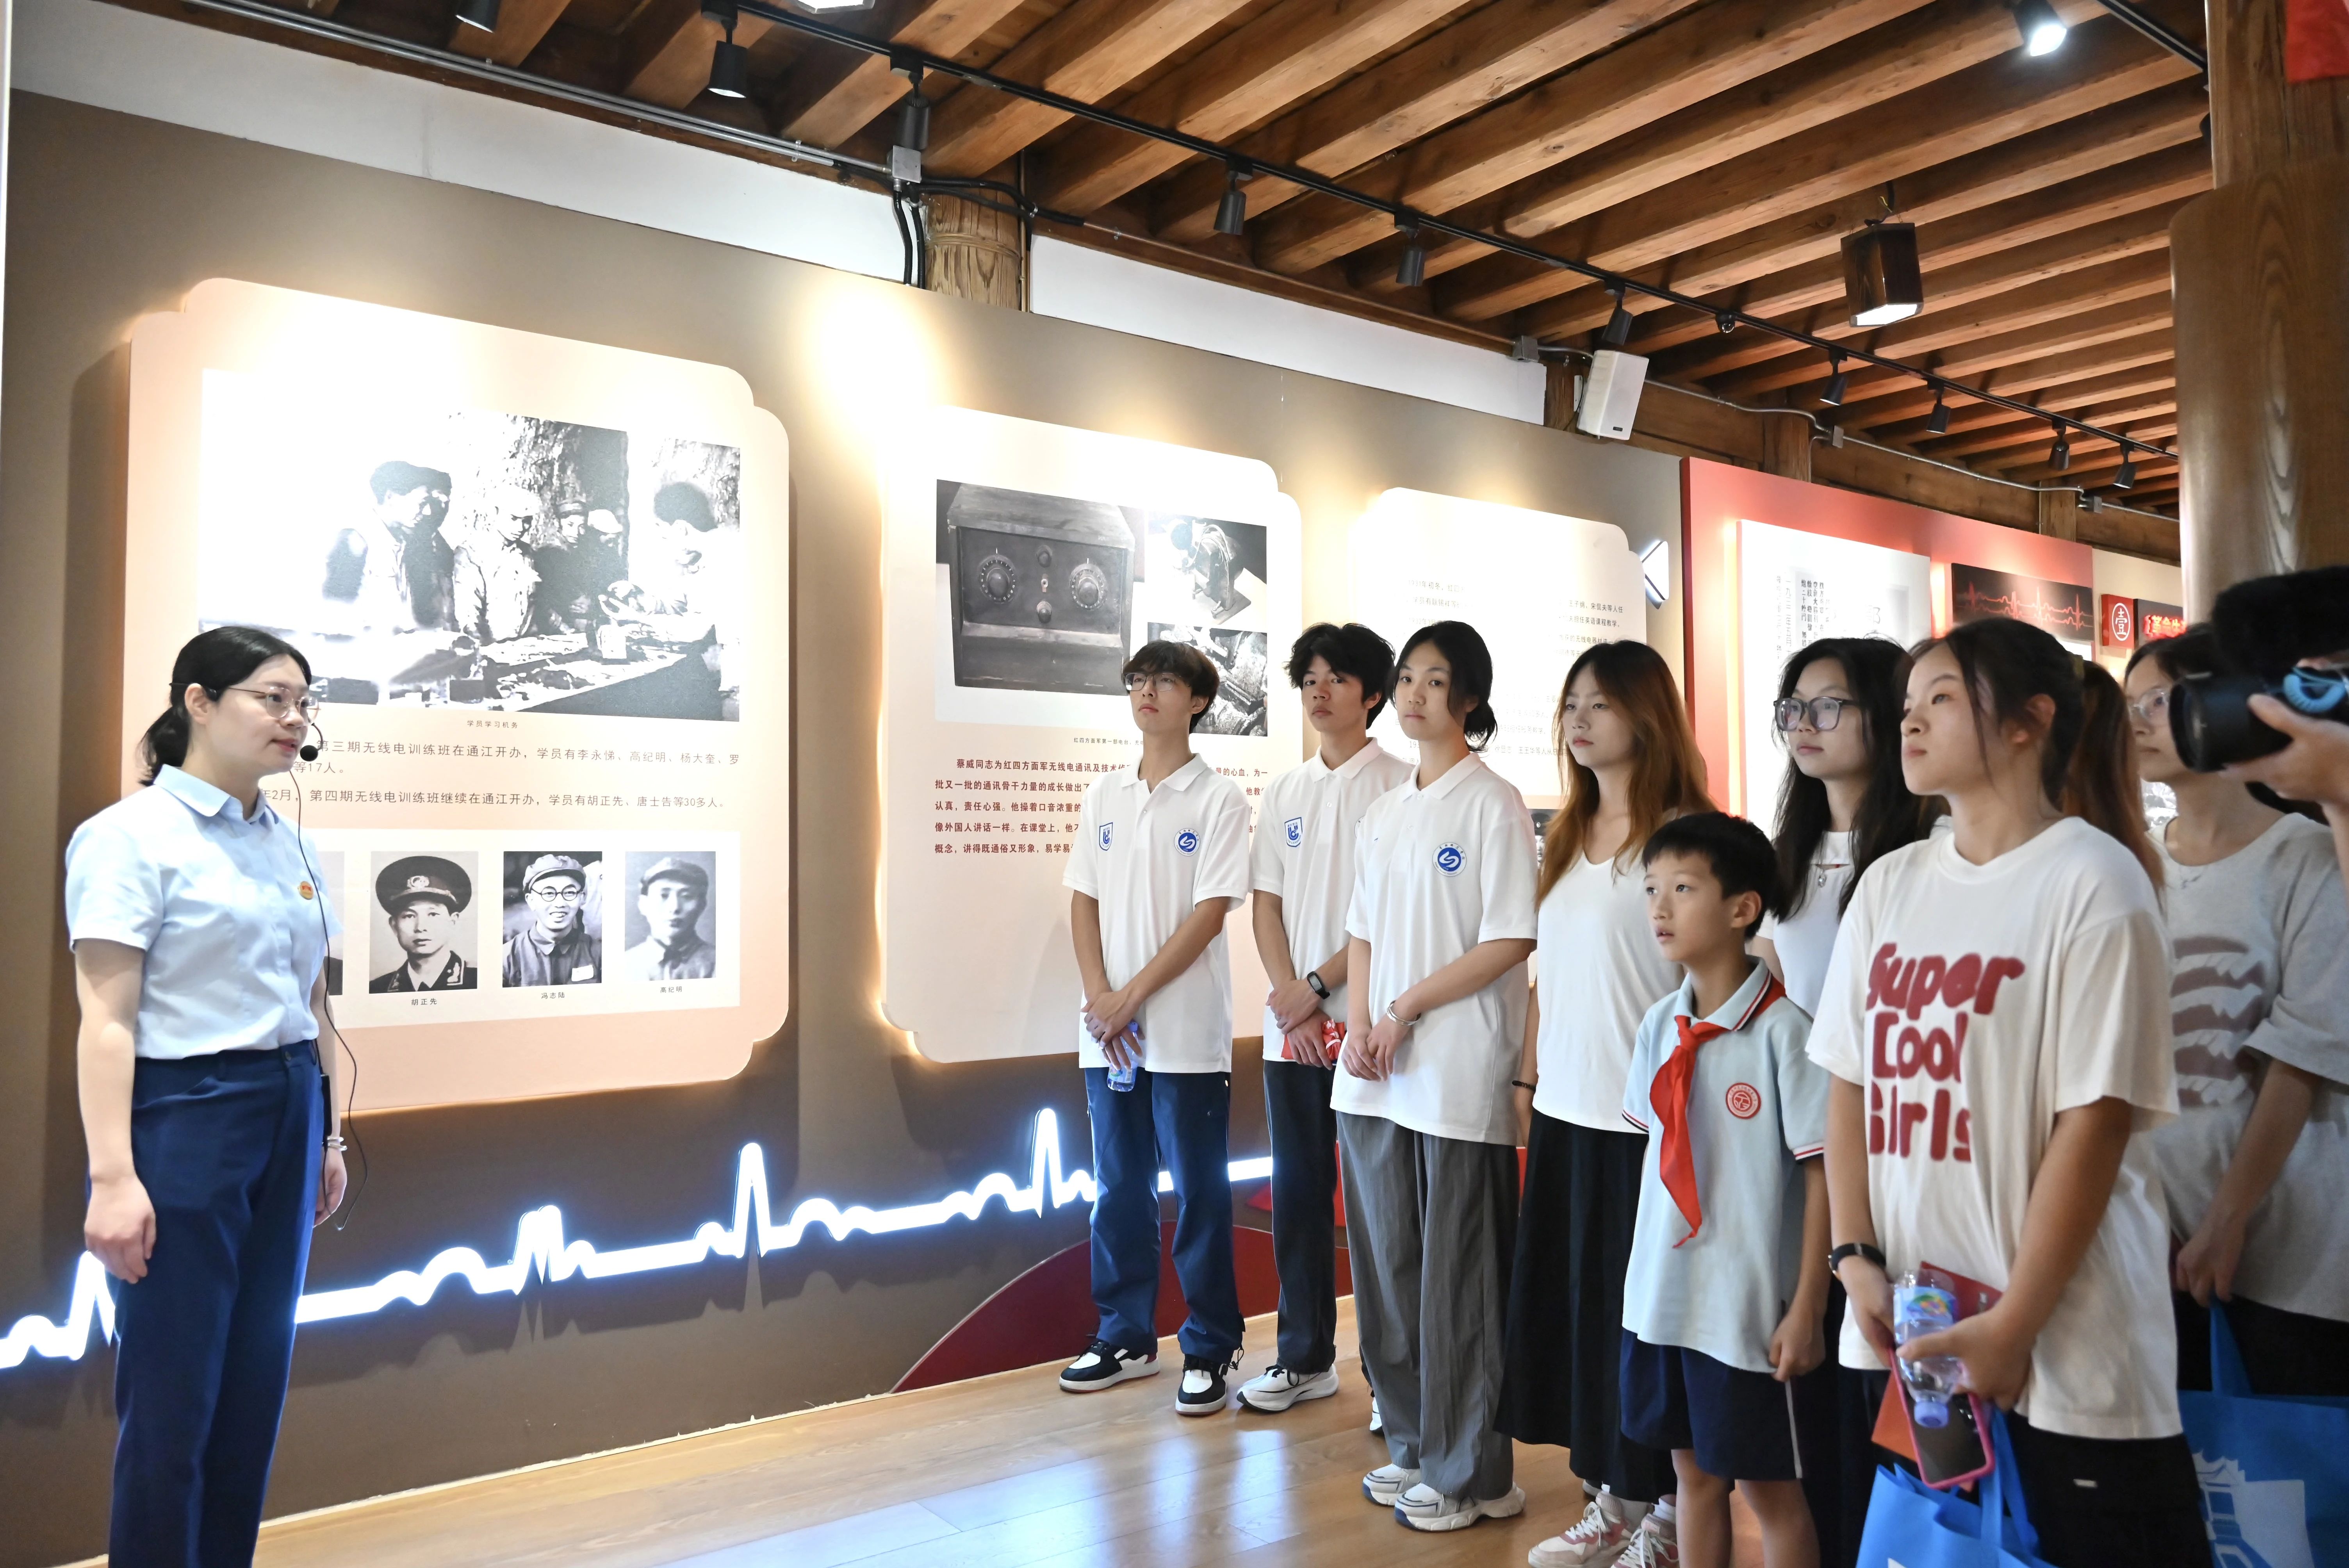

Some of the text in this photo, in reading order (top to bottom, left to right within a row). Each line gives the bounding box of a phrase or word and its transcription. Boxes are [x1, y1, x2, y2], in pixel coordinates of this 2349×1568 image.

[2115, 608, 2127, 635] 壹
[467, 720, 518, 729] 学员学习机务
[294, 761, 344, 774] 等17人。
[1246, 787, 1265, 795] 他教
[935, 843, 1073, 853] 概念，讲得既通俗又形象，易学易
